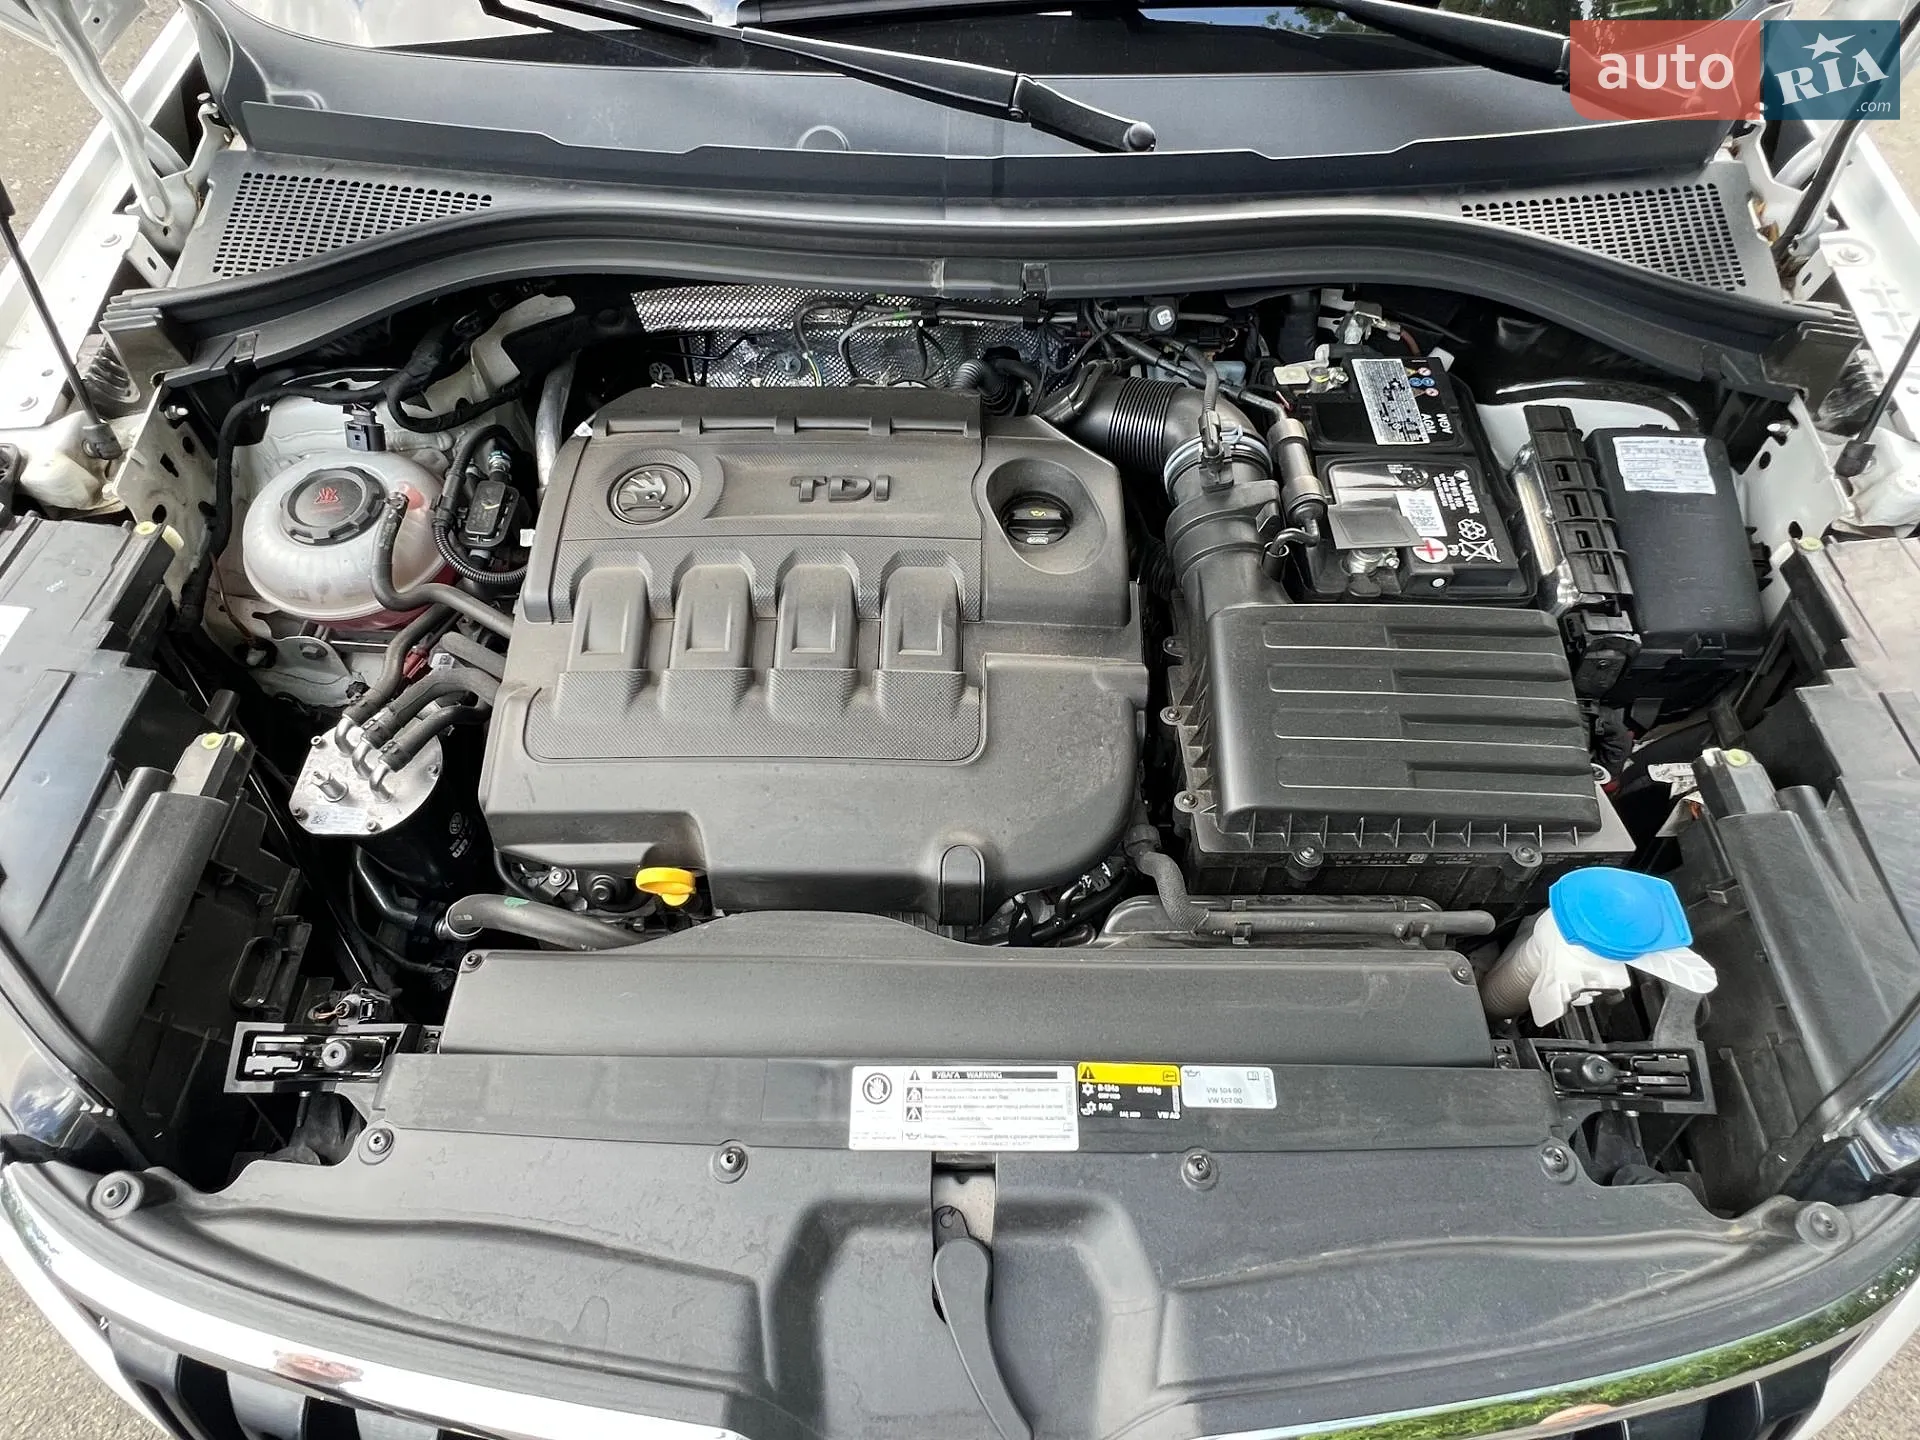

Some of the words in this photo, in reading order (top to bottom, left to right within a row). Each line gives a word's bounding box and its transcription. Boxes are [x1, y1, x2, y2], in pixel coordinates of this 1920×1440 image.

[1436, 413, 1453, 434] AGM
[791, 475, 891, 502] TDI
[1459, 481, 1480, 514] VARTA
[966, 1071, 1003, 1080] WARNING
